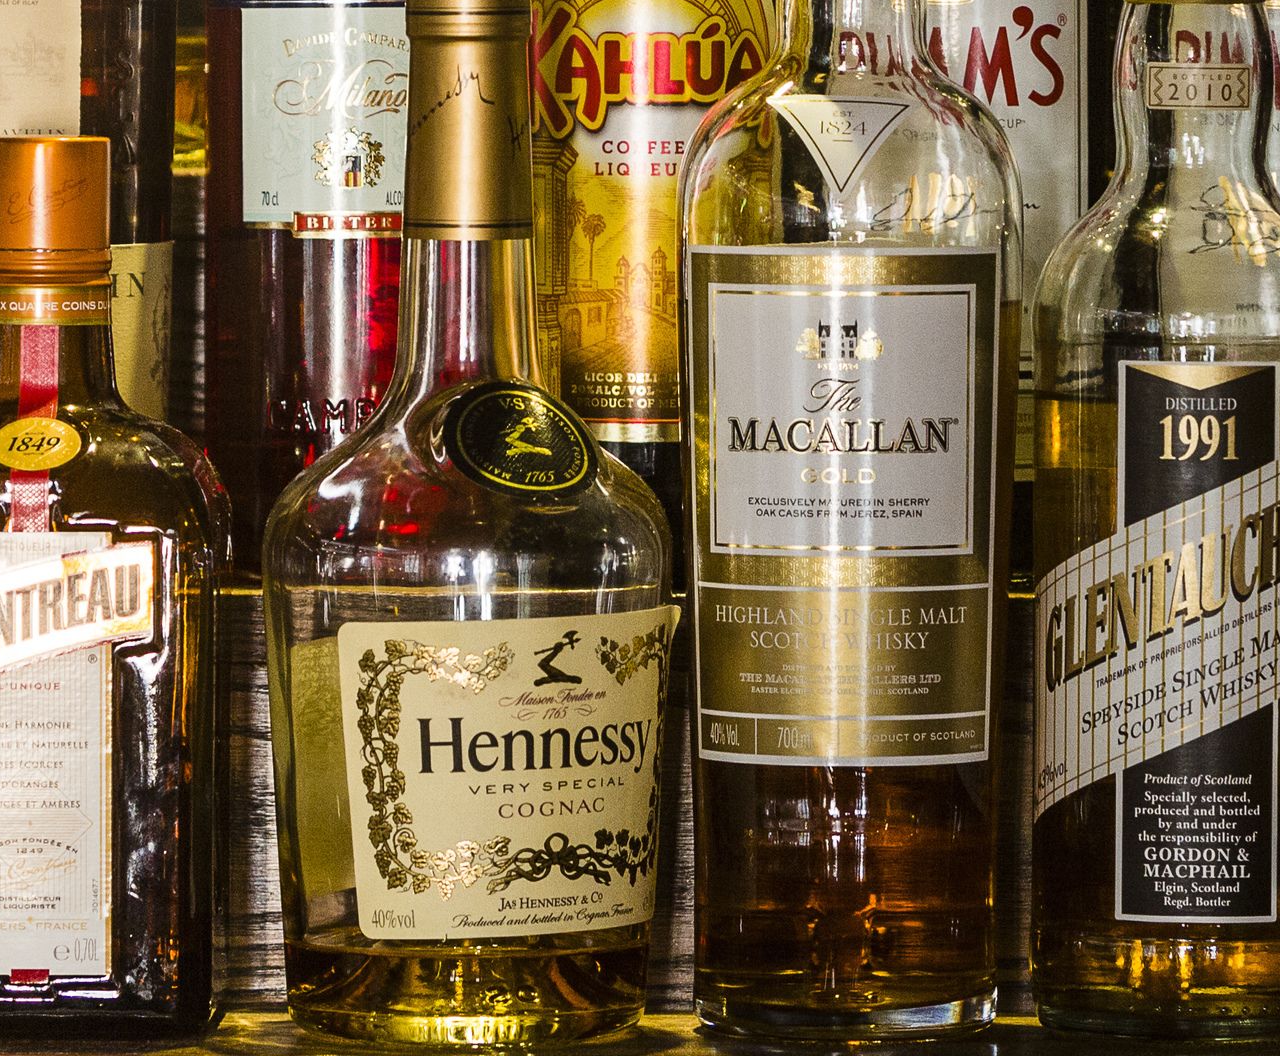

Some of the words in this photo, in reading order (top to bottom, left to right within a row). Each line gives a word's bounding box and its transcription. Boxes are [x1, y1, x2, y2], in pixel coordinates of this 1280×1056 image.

[1167, 83, 1233, 103] 2010
[819, 121, 868, 136] 1824
[62, 301, 96, 311] COINS
[803, 378, 863, 412] The
[1165, 397, 1237, 411] DISTILLED
[728, 417, 954, 454] MACALLAN
[1158, 415, 1240, 461] 1991
[7, 436, 60, 452] 1849
[800, 467, 877, 484] GOLD
[889, 497, 930, 507] SHERRY
[756, 509, 776, 517] OAK
[779, 509, 814, 518] CASKS
[892, 510, 923, 518] SPAIN
[920, 607, 967, 624] MALT
[1081, 681, 1167, 734] SPEYSIDE
[1172, 648, 1245, 693] SINGLE
[1117, 699, 1193, 746] SCOTCH
[1200, 659, 1279, 709] WHISKY
[417, 717, 653, 774] Hennessy
[469, 782, 530, 794] VERY
[542, 776, 625, 791] SPECIAL
[1144, 774, 1187, 784] Product
[1191, 774, 1203, 787] of
[1204, 775, 1252, 784] Scotland
[1144, 791, 1196, 805] Specially
[1201, 792, 1250, 804] selected,
[499, 797, 605, 819] COGNAC
[1134, 805, 1189, 817] produced
[1194, 806, 1215, 815] and
[1220, 805, 1260, 816] bottled
[1159, 819, 1172, 831] by
[1177, 819, 1197, 829] and
[1203, 819, 1237, 829] under
[1139, 831, 1156, 842] the
[1160, 832, 1241, 845] responsibility
[1245, 832, 1257, 842] of
[1144, 848, 1230, 861] GORDON
[1237, 848, 1249, 861] &
[1144, 864, 1250, 878] MACPHAIL
[1155, 882, 1187, 895] Elgin,
[1191, 882, 1240, 893] Scotland
[520, 898, 579, 909] HENNESSY
[1164, 897, 1192, 909] Regd.
[1196, 897, 1231, 906] Bottler
